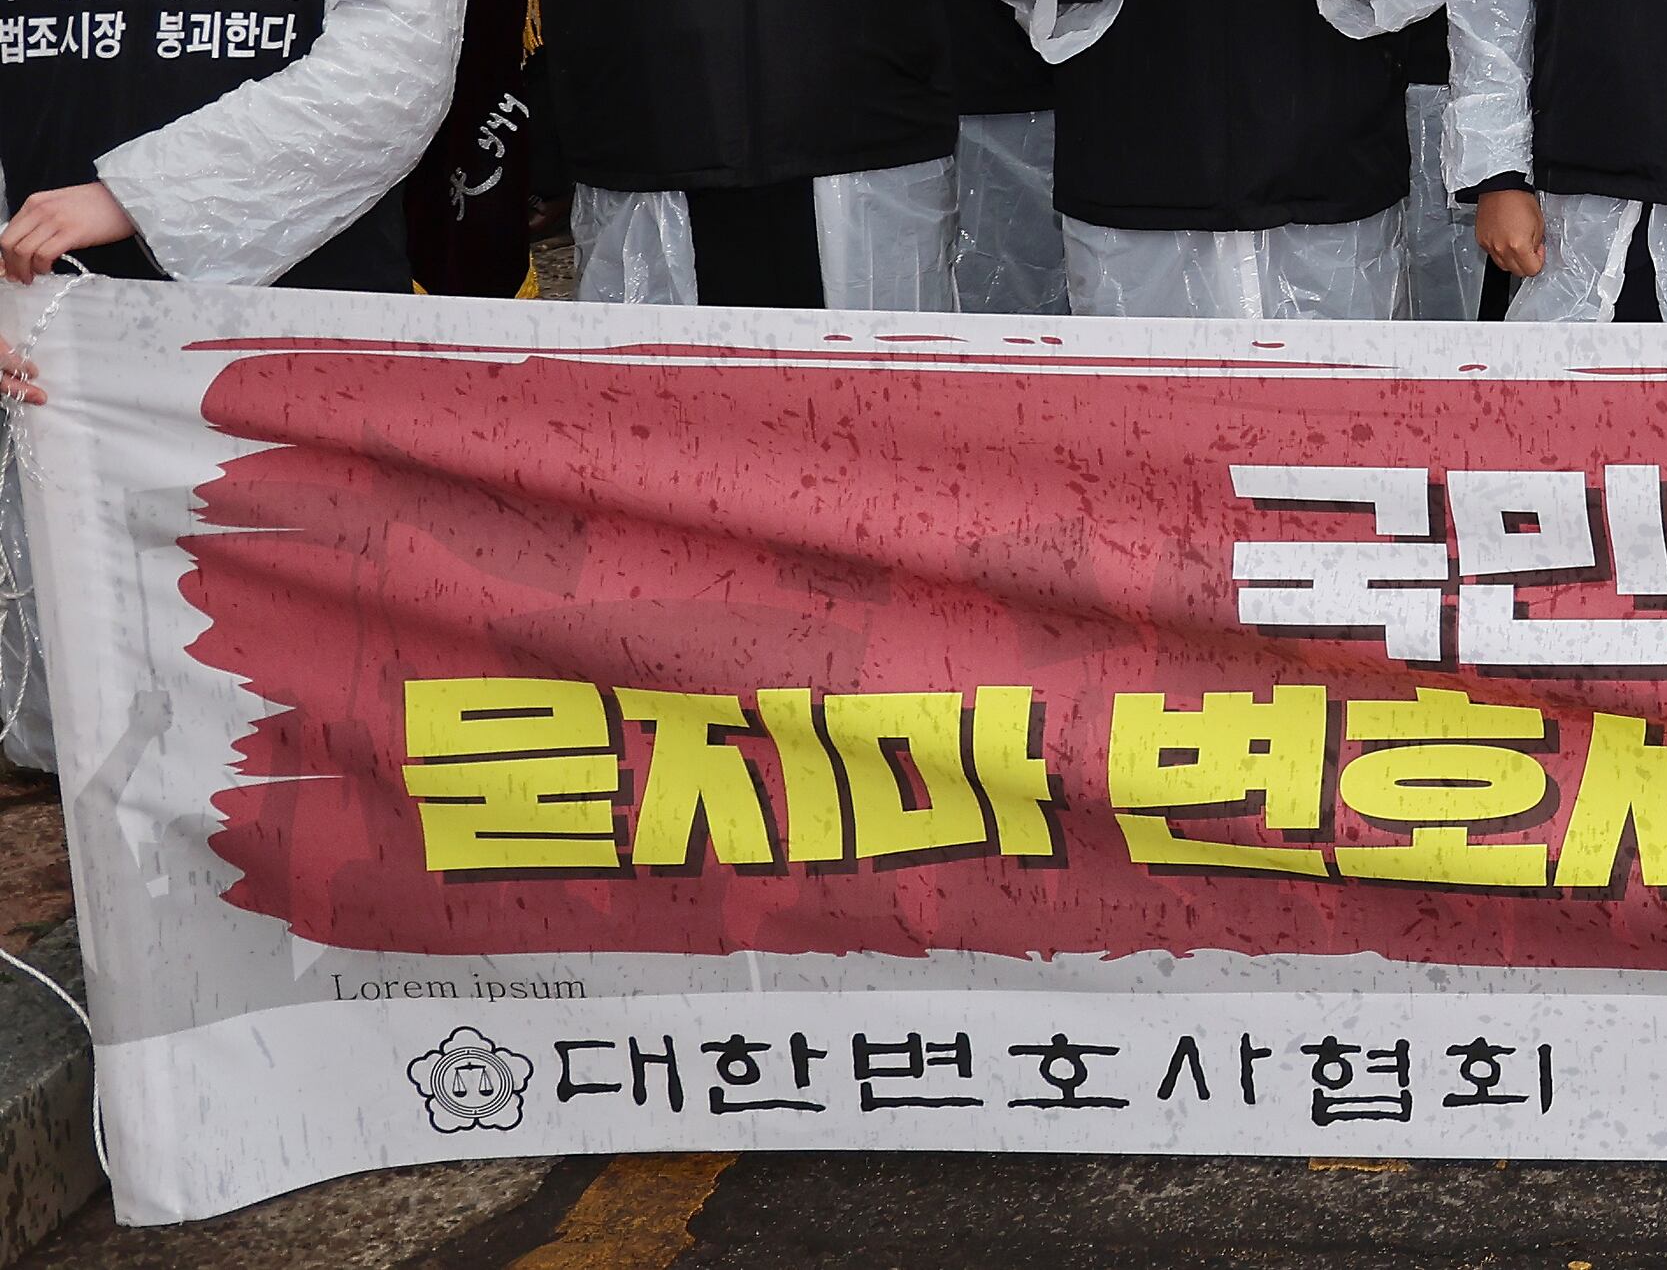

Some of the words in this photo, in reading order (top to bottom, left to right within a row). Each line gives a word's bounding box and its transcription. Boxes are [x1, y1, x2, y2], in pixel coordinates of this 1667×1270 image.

[156, 11, 297, 60] 붕괴한다
[400, 674, 1062, 875] 묻지마
[333, 973, 459, 1003] Lorem
[472, 973, 589, 1005] ipsum
[554, 1030, 1554, 1128] 대한변호사협회
